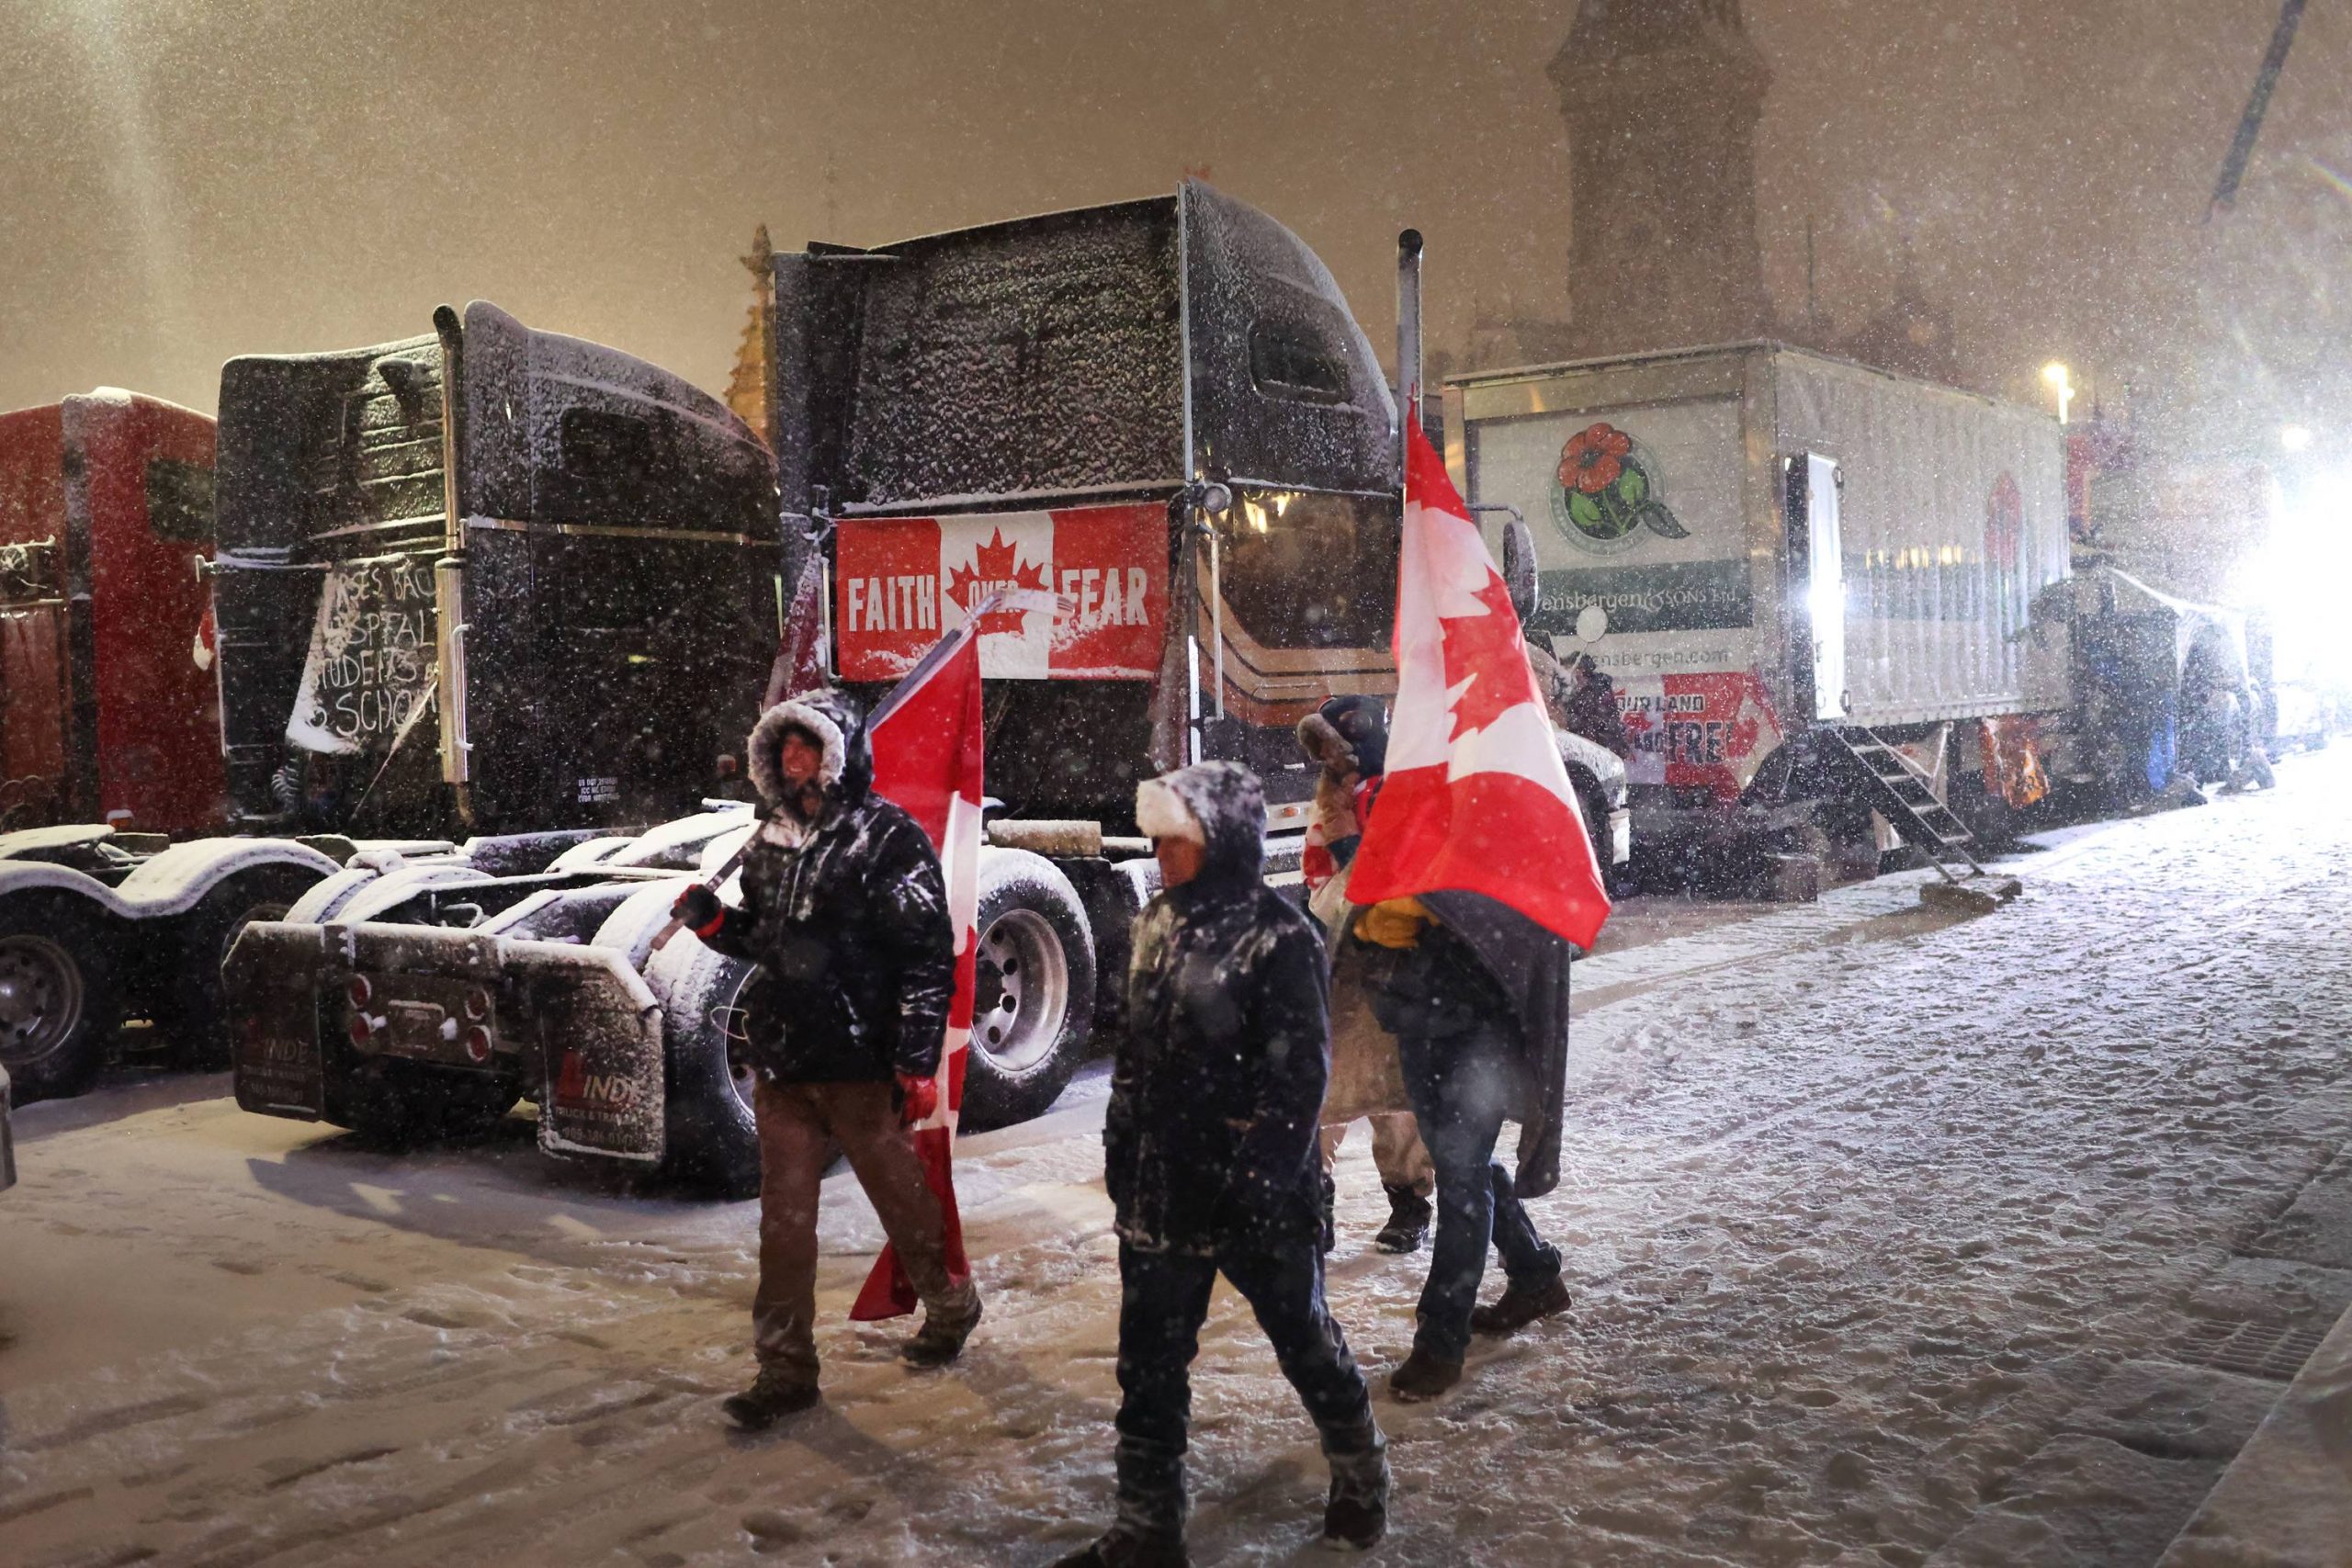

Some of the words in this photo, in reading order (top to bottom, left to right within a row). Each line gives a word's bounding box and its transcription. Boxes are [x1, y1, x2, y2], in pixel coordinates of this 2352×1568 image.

[392, 567, 436, 600] BAC
[848, 574, 935, 632] FAITH
[1061, 567, 1149, 627] FEAR
[1537, 591, 1643, 614] ensbergen
[1594, 648, 1729, 669] ensbergen.com
[1656, 695, 1704, 713] LAND
